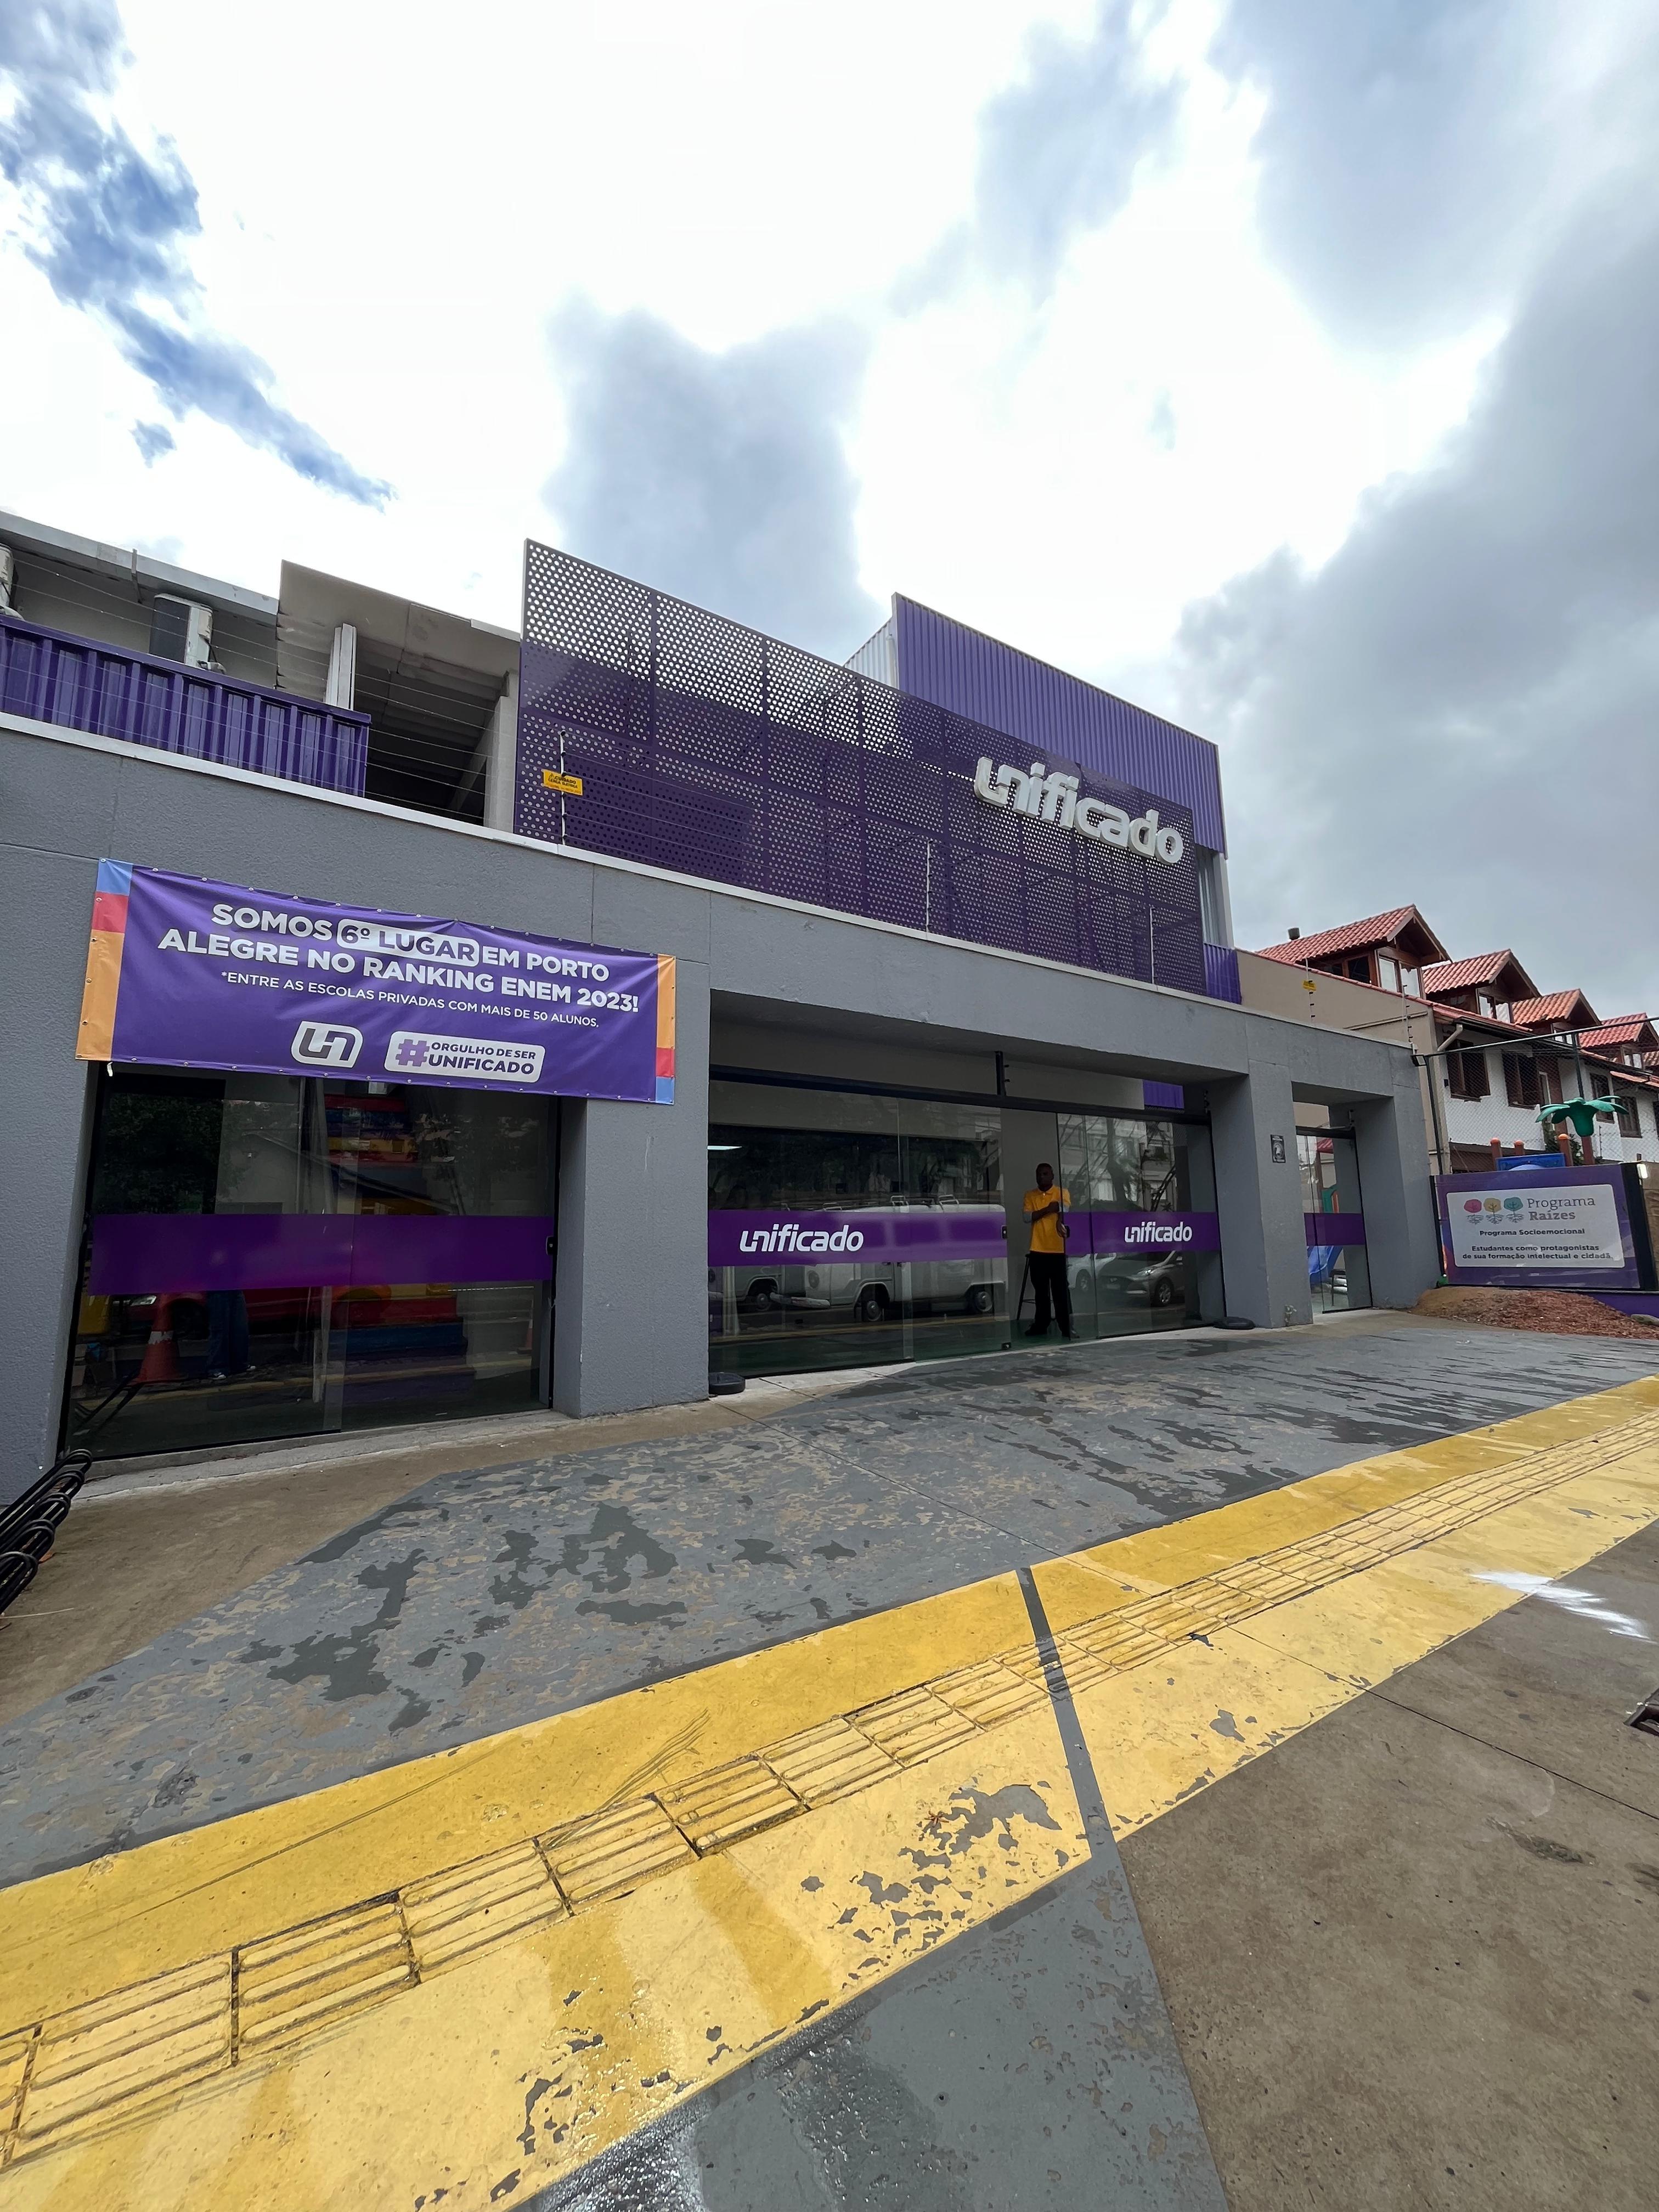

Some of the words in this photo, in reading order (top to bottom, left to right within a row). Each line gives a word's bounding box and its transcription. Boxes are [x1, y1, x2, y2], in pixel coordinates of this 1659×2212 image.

[974, 757, 1183, 865] unificado
[211, 904, 333, 941] SOMOS
[379, 930, 476, 961] LUGAR
[482, 945, 520, 968] EM
[527, 952, 610, 982] PORTO
[157, 928, 299, 966] ALEGRE
[308, 949, 356, 974] NO
[363, 956, 494, 993] RANKING
[501, 976, 571, 1004] ENEM
[577, 988, 640, 1013] 2023!
[283, 979, 304, 992] AS
[308, 983, 375, 1001] ESCOLAS
[378, 991, 445, 1009] PRIVADAS
[448, 1000, 477, 1013] COM
[481, 1005, 511, 1018] MAIS
[514, 1009, 531, 1019] DE
[533, 1011, 548, 1022] 50
[551, 1013, 600, 1028] ALUNOS.
[431, 1042, 494, 1056] ORGULHO
[496, 1048, 512, 1058] DE
[514, 1049, 537, 1060] SER
[428, 1056, 535, 1075] UNIFICADO
[1527, 1197, 1595, 1210] Programa
[1529, 1210, 1576, 1221] Raízes
[740, 1224, 864, 1251] unificado
[1125, 1222, 1192, 1242] unificado
